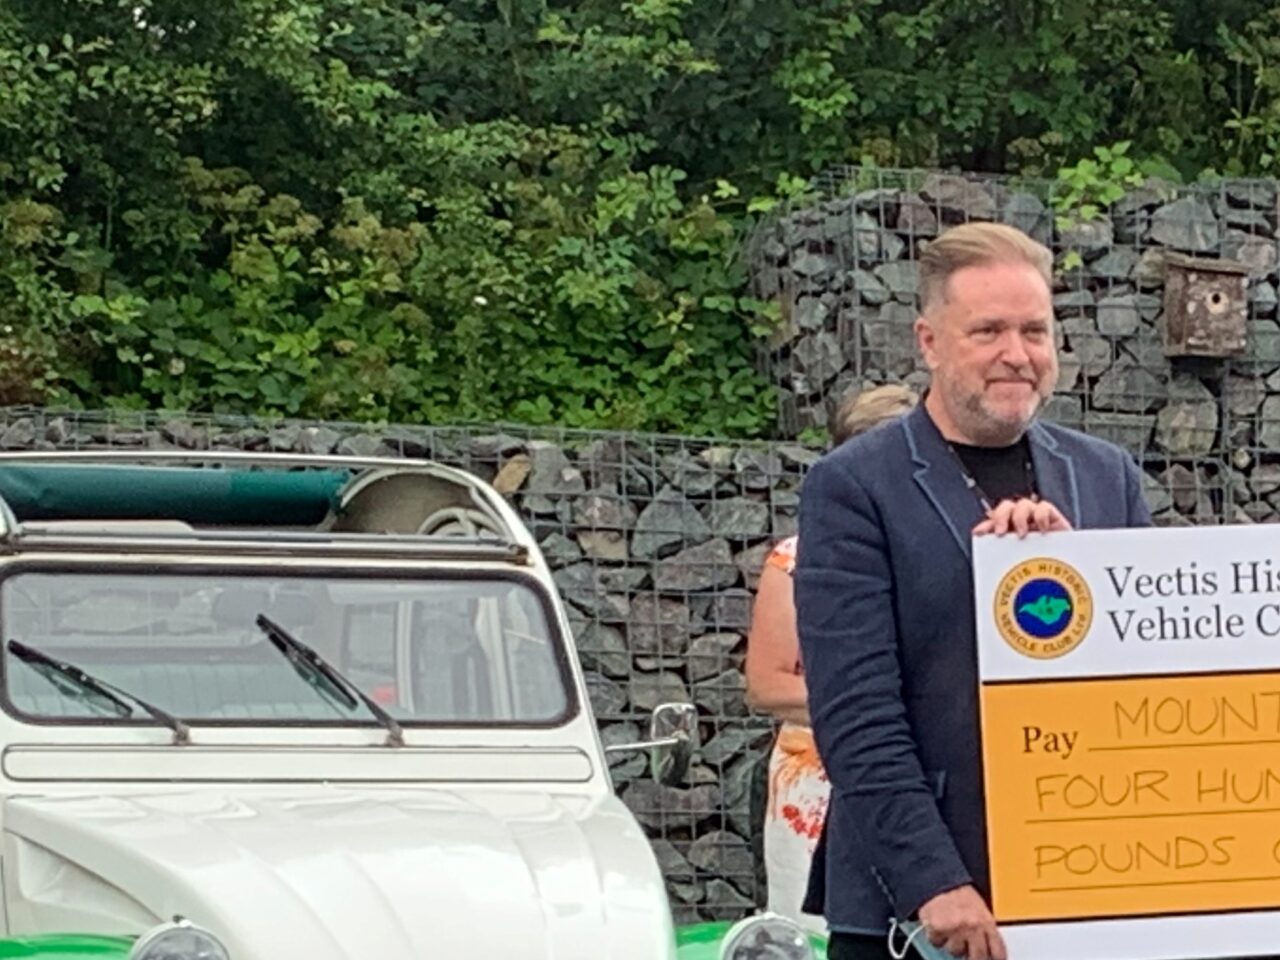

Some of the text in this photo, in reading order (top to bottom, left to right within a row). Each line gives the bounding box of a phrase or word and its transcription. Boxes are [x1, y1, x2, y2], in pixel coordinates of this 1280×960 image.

[1105, 563, 1218, 597] Vectis
[1107, 604, 1246, 642] Vehicle
[1022, 726, 1078, 759] Pay
[1035, 770, 1170, 811] FOUR
[1034, 836, 1236, 878] POUNDS
